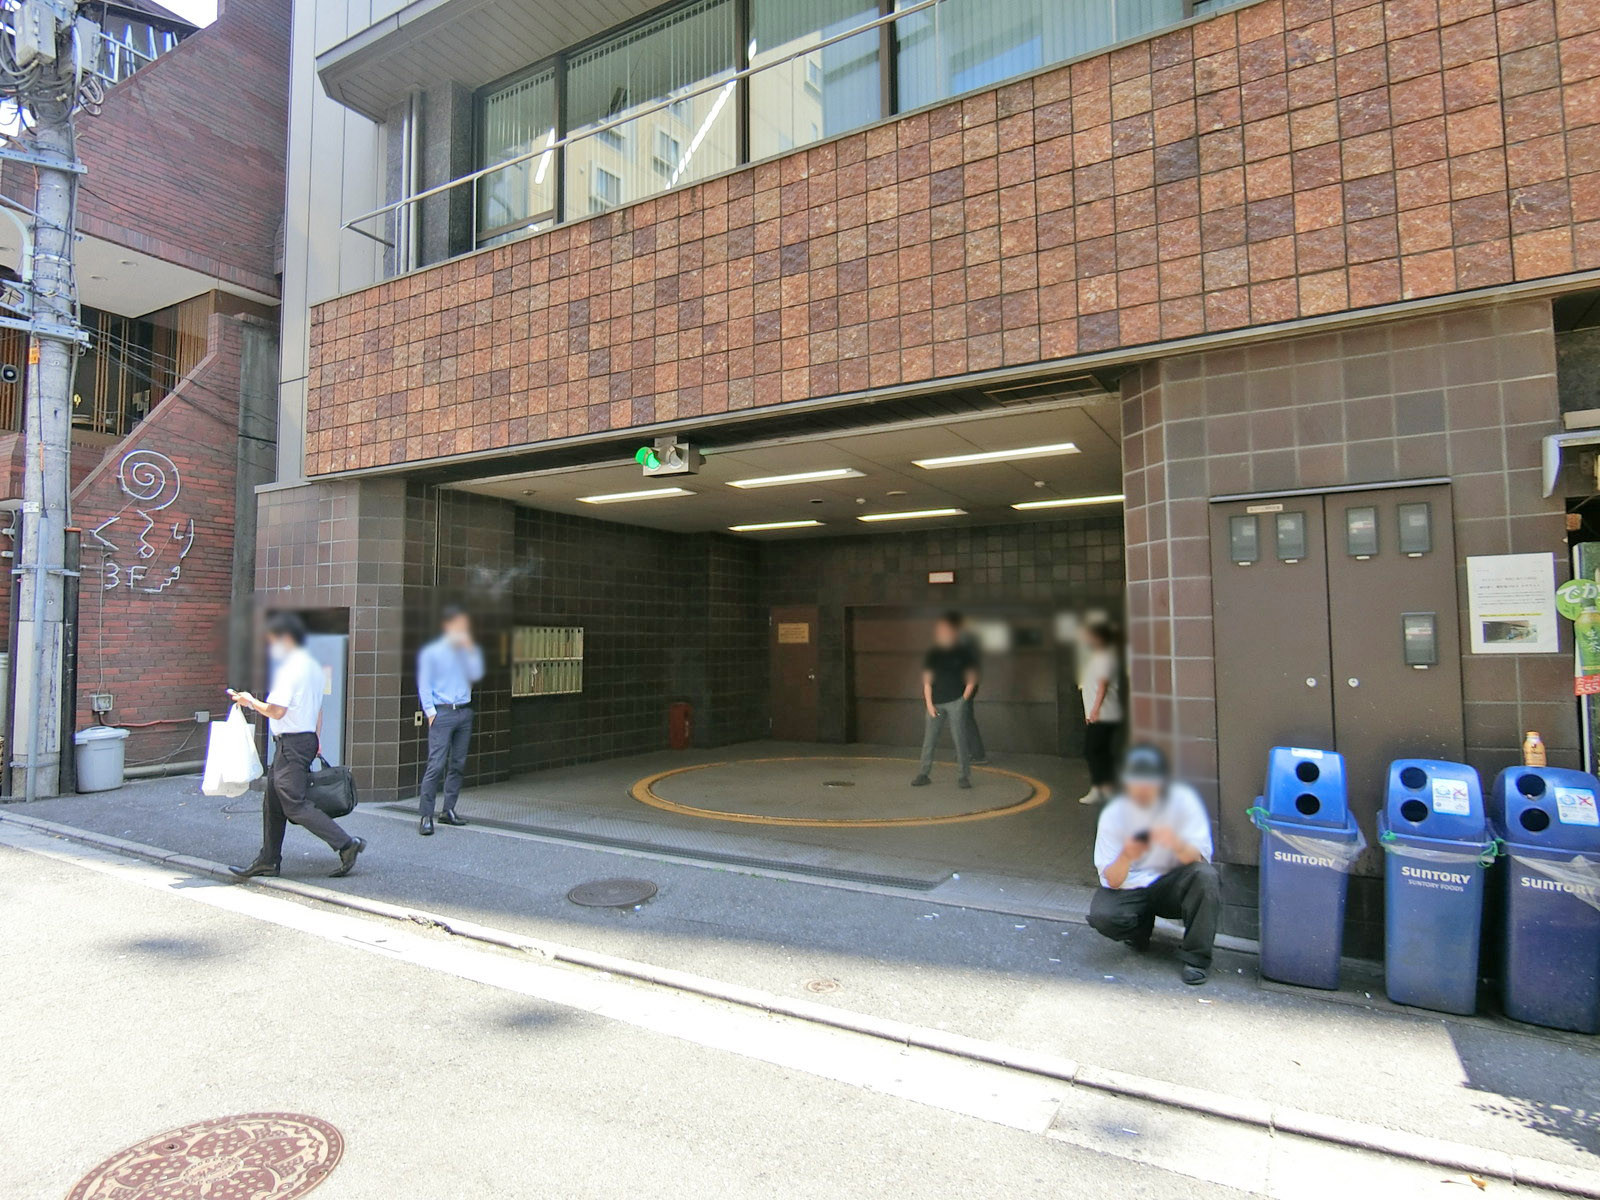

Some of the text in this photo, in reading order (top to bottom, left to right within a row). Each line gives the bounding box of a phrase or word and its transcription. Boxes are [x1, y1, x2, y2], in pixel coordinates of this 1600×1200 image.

[105, 562, 148, 590] 3F
[1274, 851, 1336, 868] SUNTORY
[1401, 866, 1471, 885] SUNTORY
[1521, 876, 1596, 895] SUNTORY
